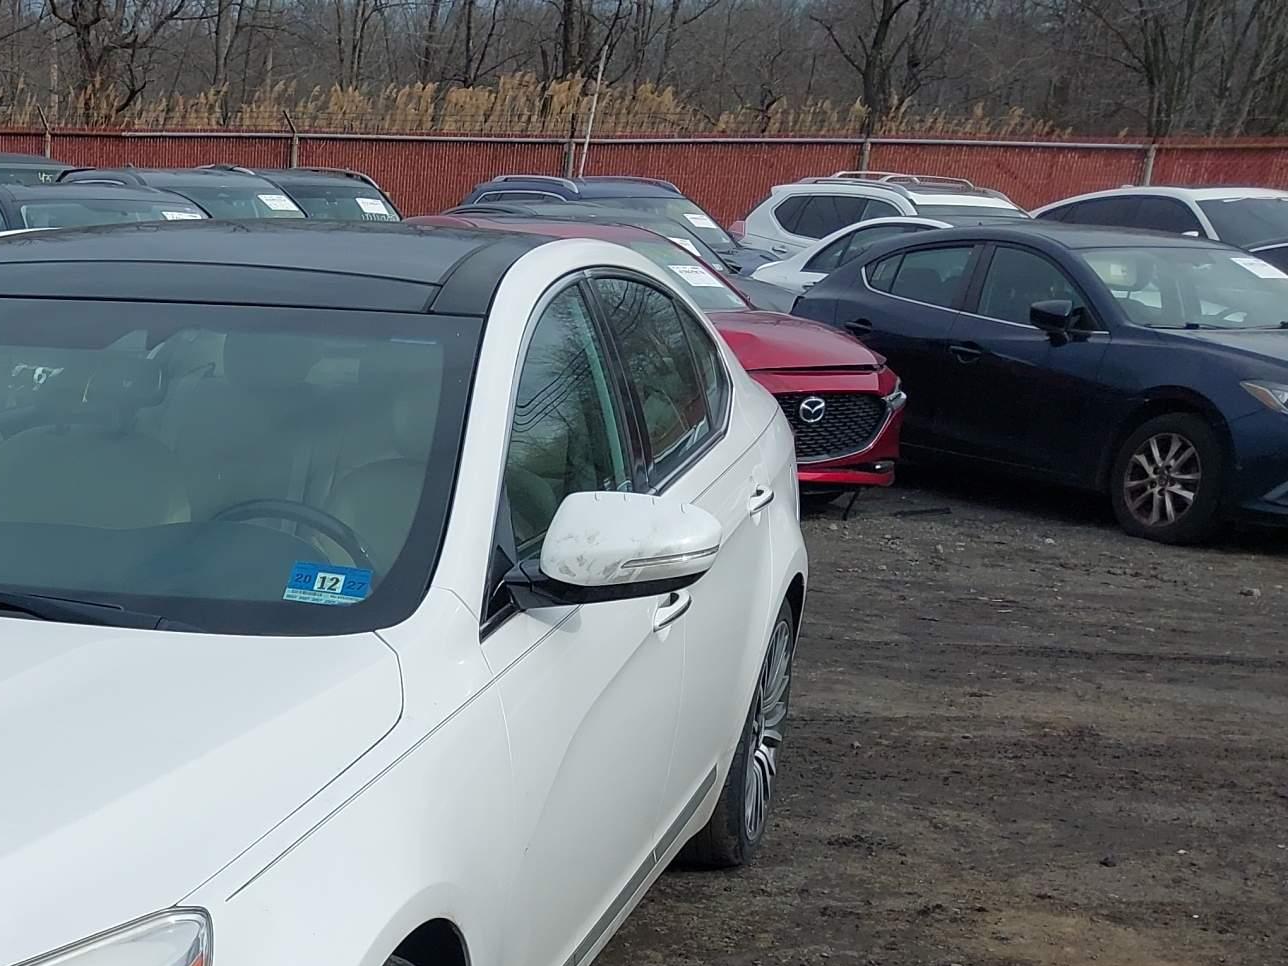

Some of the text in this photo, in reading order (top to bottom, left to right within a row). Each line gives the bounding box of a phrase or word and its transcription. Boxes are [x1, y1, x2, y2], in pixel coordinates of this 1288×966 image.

[295, 573, 367, 591] 20 12 27
